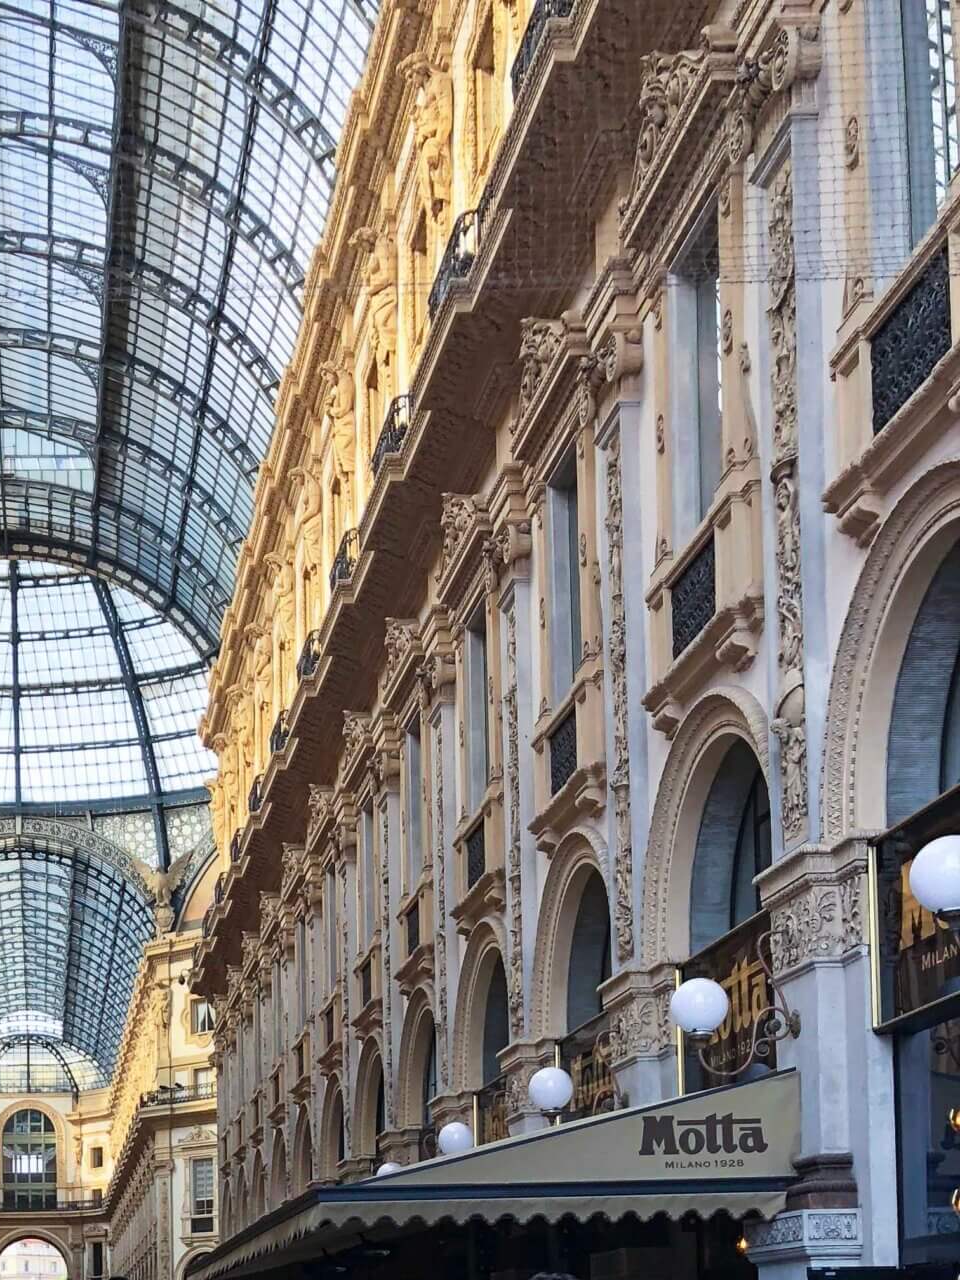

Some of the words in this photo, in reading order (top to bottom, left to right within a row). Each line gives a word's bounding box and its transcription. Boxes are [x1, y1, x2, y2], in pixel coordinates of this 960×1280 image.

[638, 1112, 769, 1156] Motta
[664, 1160, 711, 1169] MILANO
[714, 1159, 745, 1168] 1928
